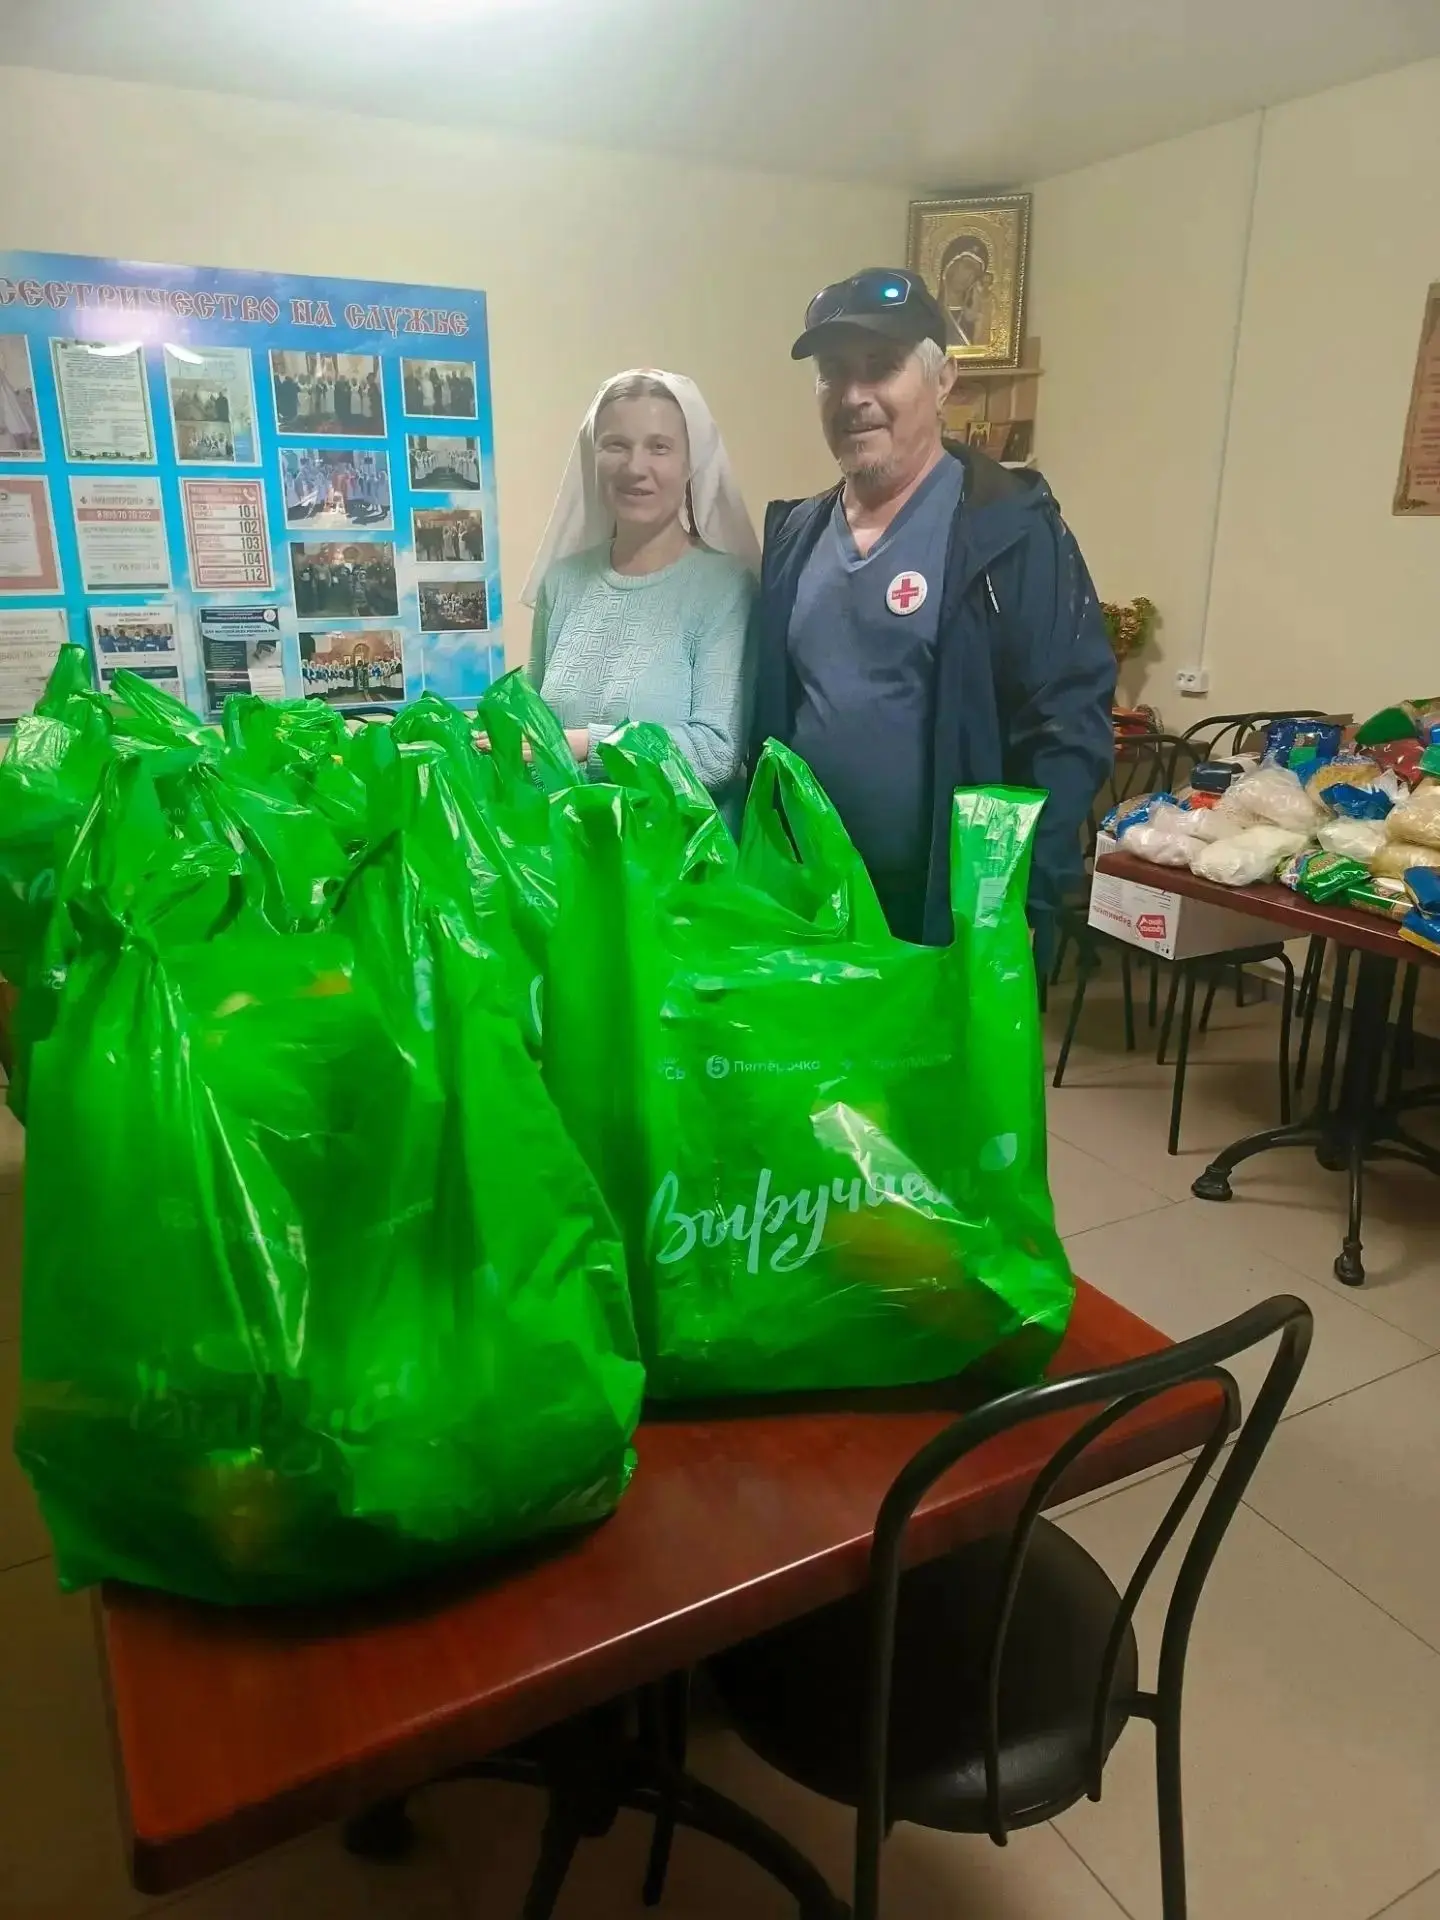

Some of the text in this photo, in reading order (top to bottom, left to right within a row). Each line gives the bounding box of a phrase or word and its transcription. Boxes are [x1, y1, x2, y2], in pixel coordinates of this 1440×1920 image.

[290, 299, 337, 328] НА
[344, 303, 470, 339] СЛУЖБЕ
[239, 505, 258, 518] 101
[240, 521, 258, 534] 102
[241, 537, 260, 550] 103
[243, 552, 261, 565] 104
[244, 568, 263, 581] 112
